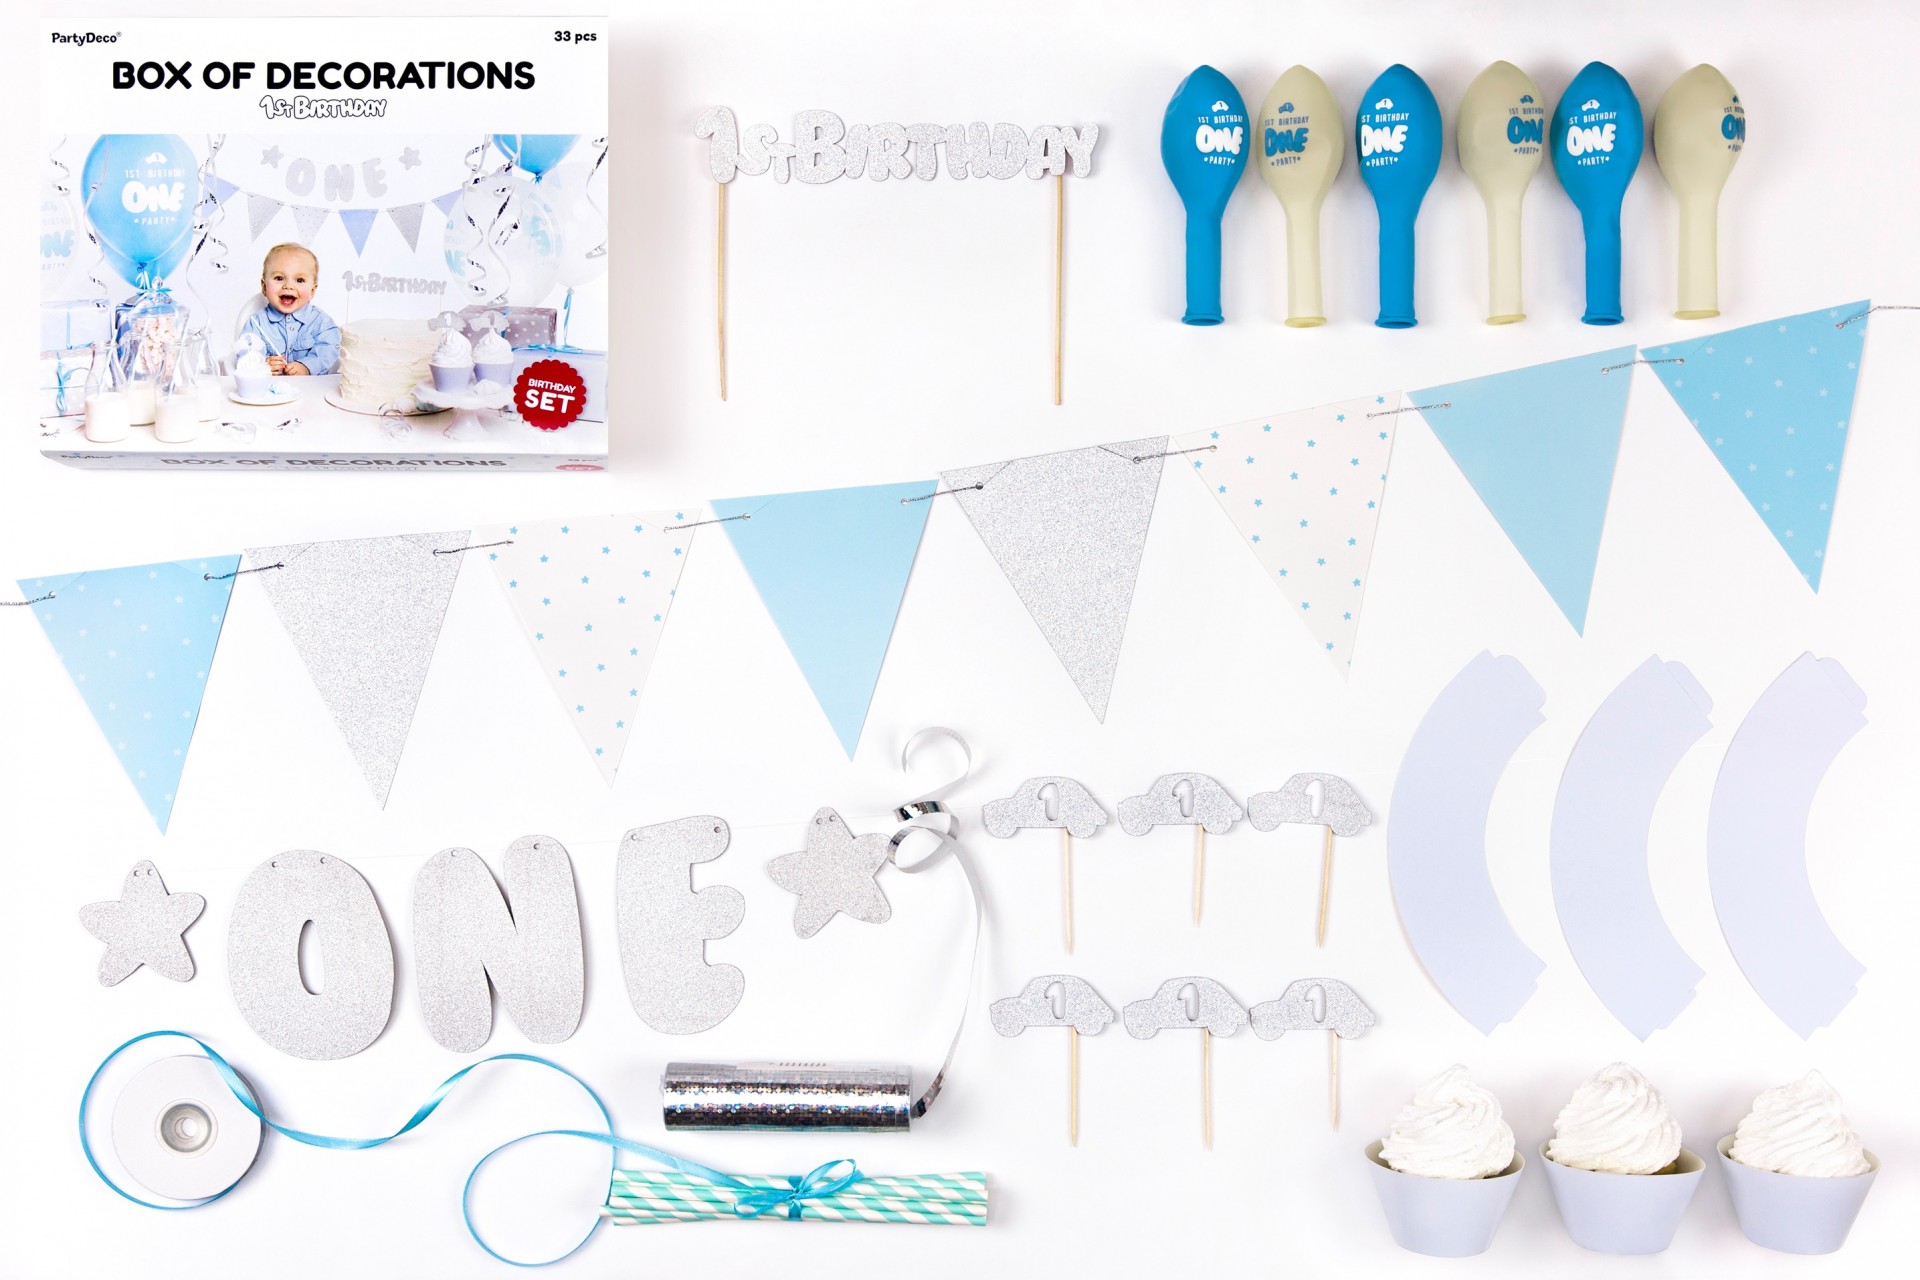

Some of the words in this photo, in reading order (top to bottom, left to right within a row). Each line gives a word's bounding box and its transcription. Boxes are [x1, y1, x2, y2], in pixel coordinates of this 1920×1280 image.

[554, 30, 571, 42] 33
[575, 31, 597, 44] pcs
[113, 60, 192, 90] BOX
[202, 60, 256, 90] OF
[266, 60, 536, 90] DECORATIONS
[1197, 116, 1209, 124] 1ST
[1278, 116, 1310, 126] BIRTHDAY
[1375, 112, 1410, 123] BIRTHDAY
[1583, 111, 1617, 123] BIRTHDAY
[1195, 124, 1244, 155] ONE
[1264, 127, 1310, 157] ONE
[1361, 124, 1409, 157] ONE
[1566, 123, 1617, 157] ONE
[125, 169, 140, 179] 1ST
[1209, 155, 1232, 166] PARTY
[1275, 156, 1297, 167] PARTY
[1371, 156, 1393, 167] PARTY
[1582, 155, 1605, 166] PARTY
[285, 157, 388, 203] ONE
[121, 181, 185, 214] ONE
[141, 217, 170, 225] PARTY
[528, 378, 576, 393] BIRTHDAY
[524, 389, 576, 414] SET
[1037, 782, 1060, 822] 1
[1172, 778, 1194, 818] 1
[1303, 778, 1325, 818] 1
[228, 815, 746, 1061] ONE
[1043, 980, 1066, 1020] 1
[1177, 982, 1199, 1021] 1
[1303, 984, 1326, 1023] 1
